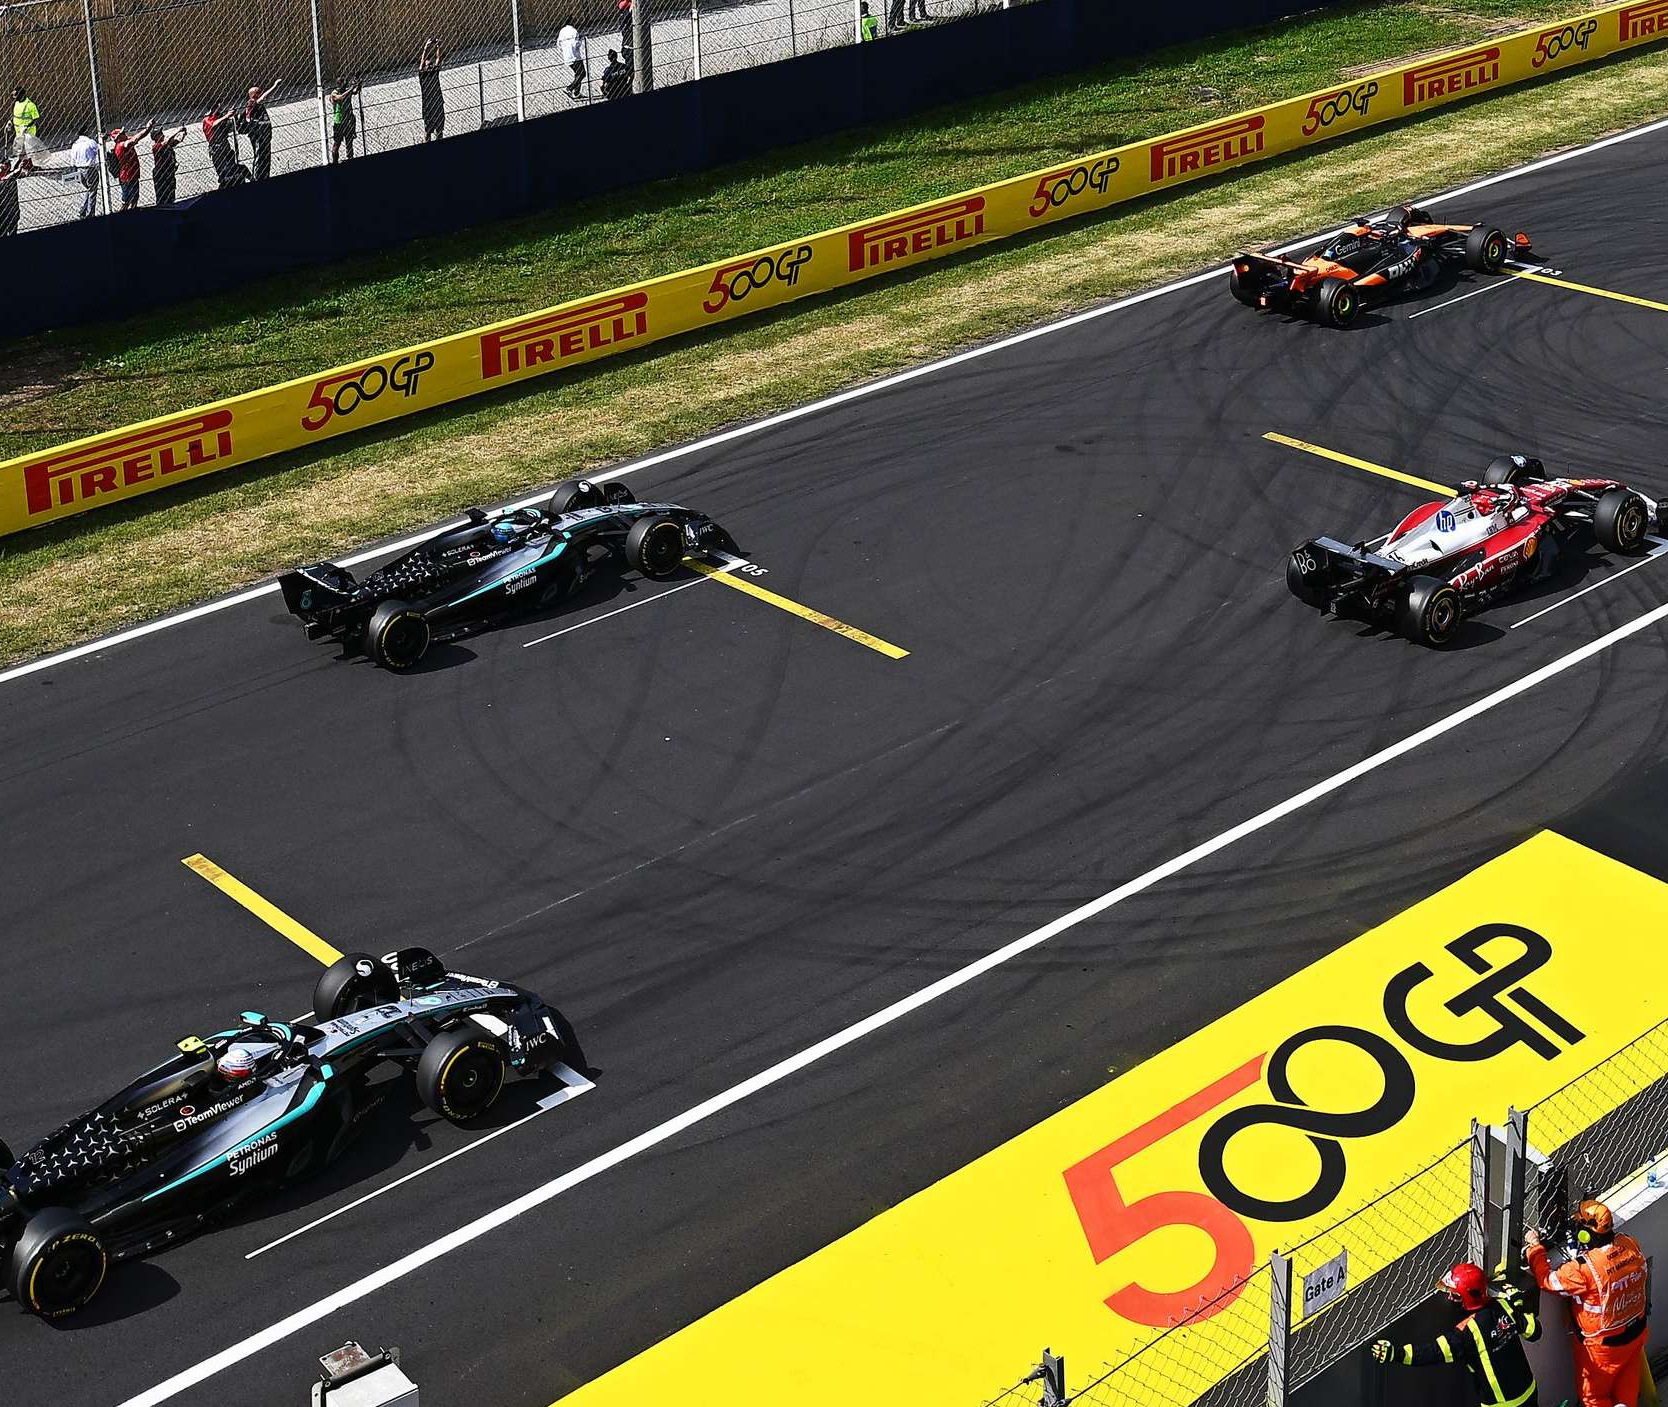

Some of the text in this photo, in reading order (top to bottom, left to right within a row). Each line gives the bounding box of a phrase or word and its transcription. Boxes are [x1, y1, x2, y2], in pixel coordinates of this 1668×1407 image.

[1403, 47, 1500, 107] PIRELLI
[1150, 115, 1265, 181] PIRELLI
[848, 195, 985, 271] PIRELLI
[1335, 238, 1361, 256] Gemini
[1540, 267, 1563, 277] 03
[480, 292, 648, 379] PIRELLI
[24, 409, 233, 515] PIRELLI
[698, 523, 714, 535] IWC
[1439, 511, 1454, 532] hp
[474, 545, 512, 565] TeamViewer
[740, 562, 769, 577] 05
[505, 575, 538, 595] Syntium
[525, 1032, 547, 1052] IWC
[145, 1096, 183, 1117] SOLERA
[185, 1093, 245, 1127] TeamViewer
[226, 1131, 278, 1162] PETRONAS
[229, 1142, 279, 1176] Syntium
[1304, 1268, 1346, 1303] Gate A
